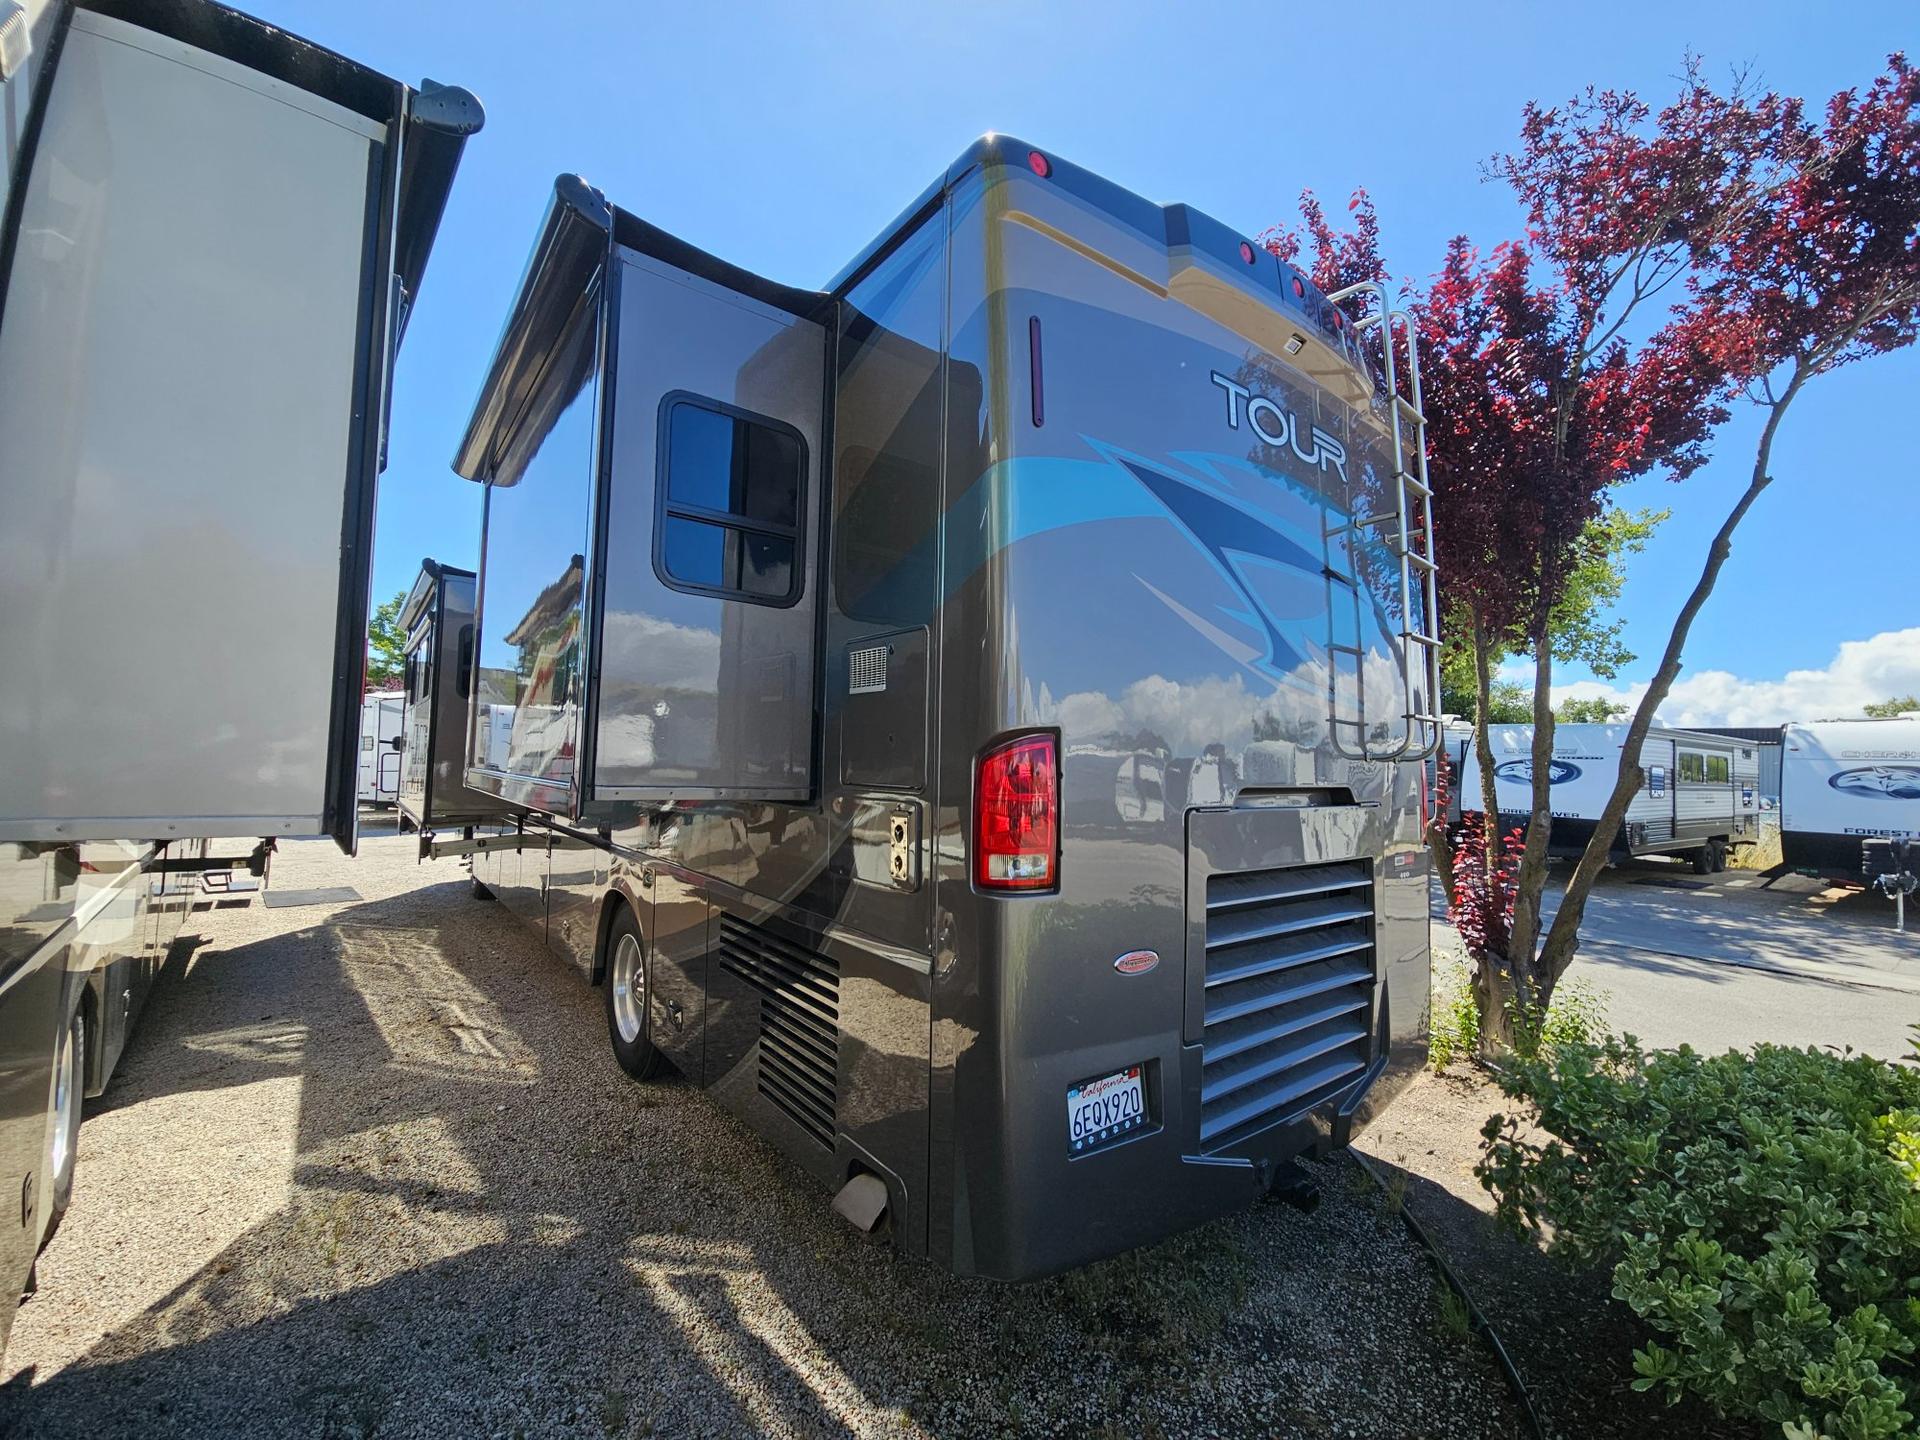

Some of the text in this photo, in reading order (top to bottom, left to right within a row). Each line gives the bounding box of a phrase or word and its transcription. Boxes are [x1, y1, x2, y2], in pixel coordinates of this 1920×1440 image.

[1211, 370, 1348, 483] TOUR
[1498, 807, 1533, 815] FORES
[1844, 827, 1912, 837] FOREST
[1080, 1076, 1129, 1099] California
[1073, 1086, 1140, 1138] 6EQX920
